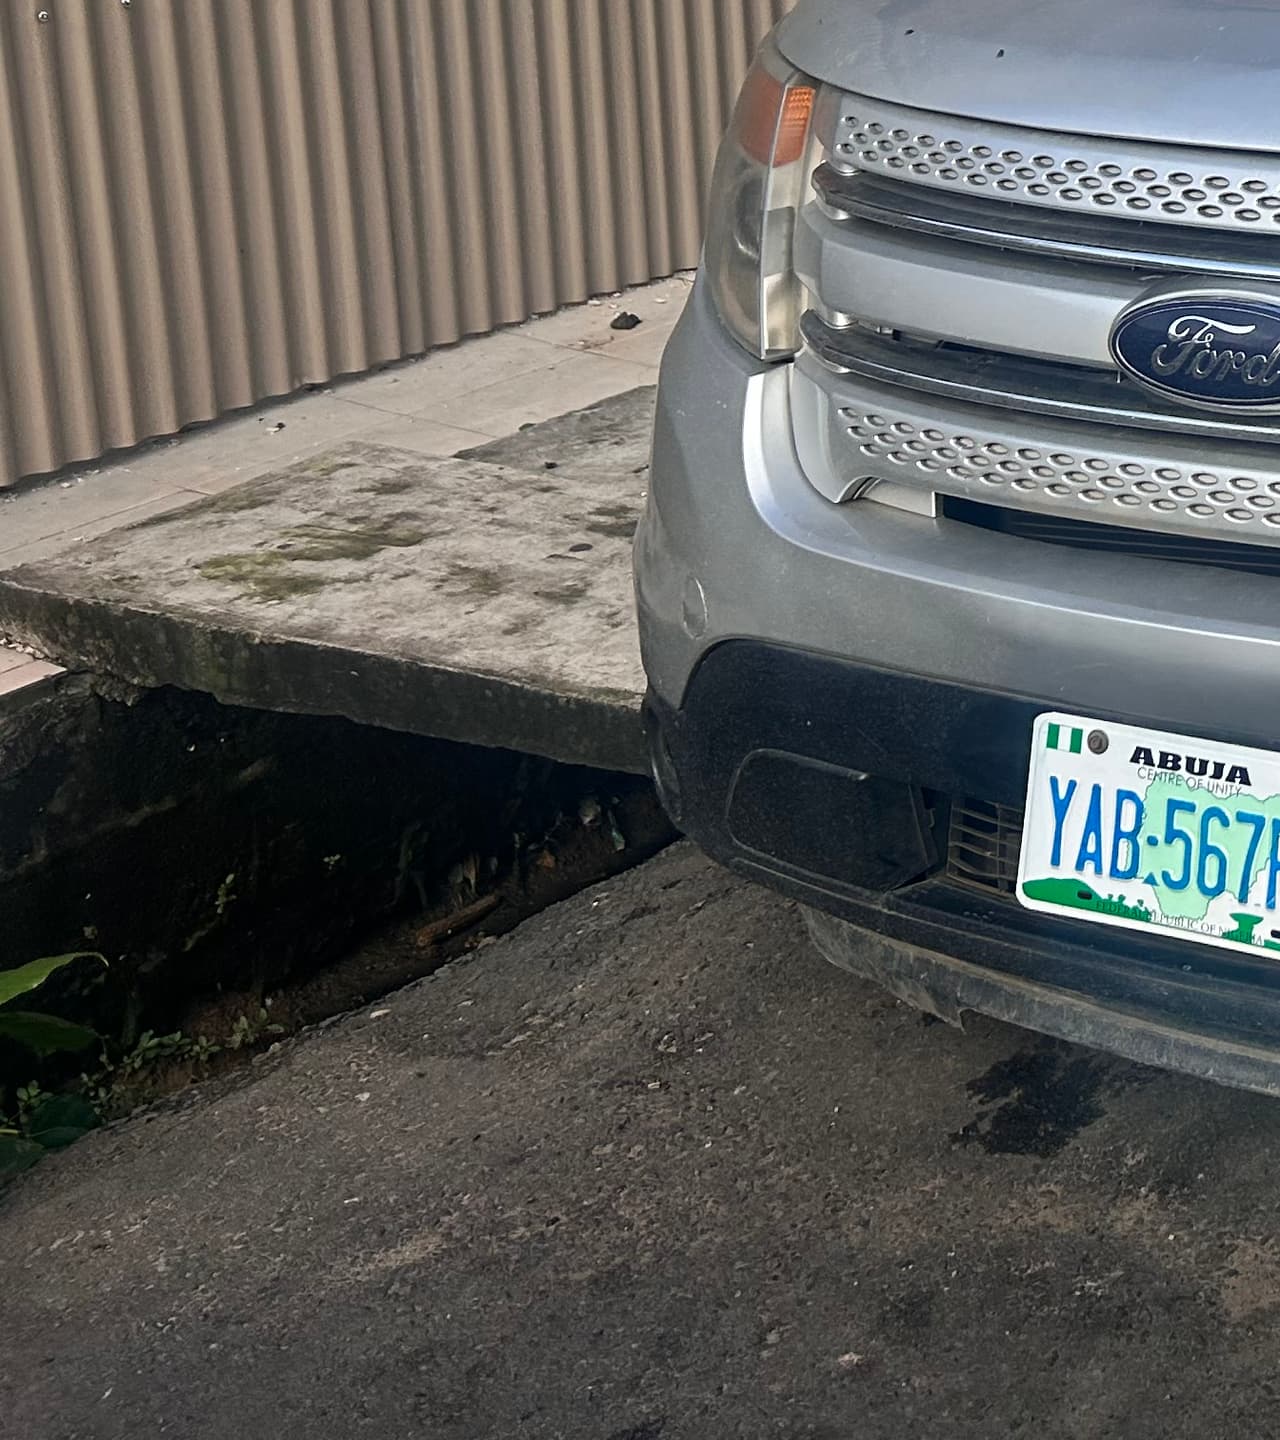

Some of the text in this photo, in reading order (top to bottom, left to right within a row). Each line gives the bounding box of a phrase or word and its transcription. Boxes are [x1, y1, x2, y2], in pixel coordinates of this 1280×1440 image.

[1130, 745, 1252, 786] ABUJA
[1137, 766, 1242, 797] CENTRE OF UNITY
